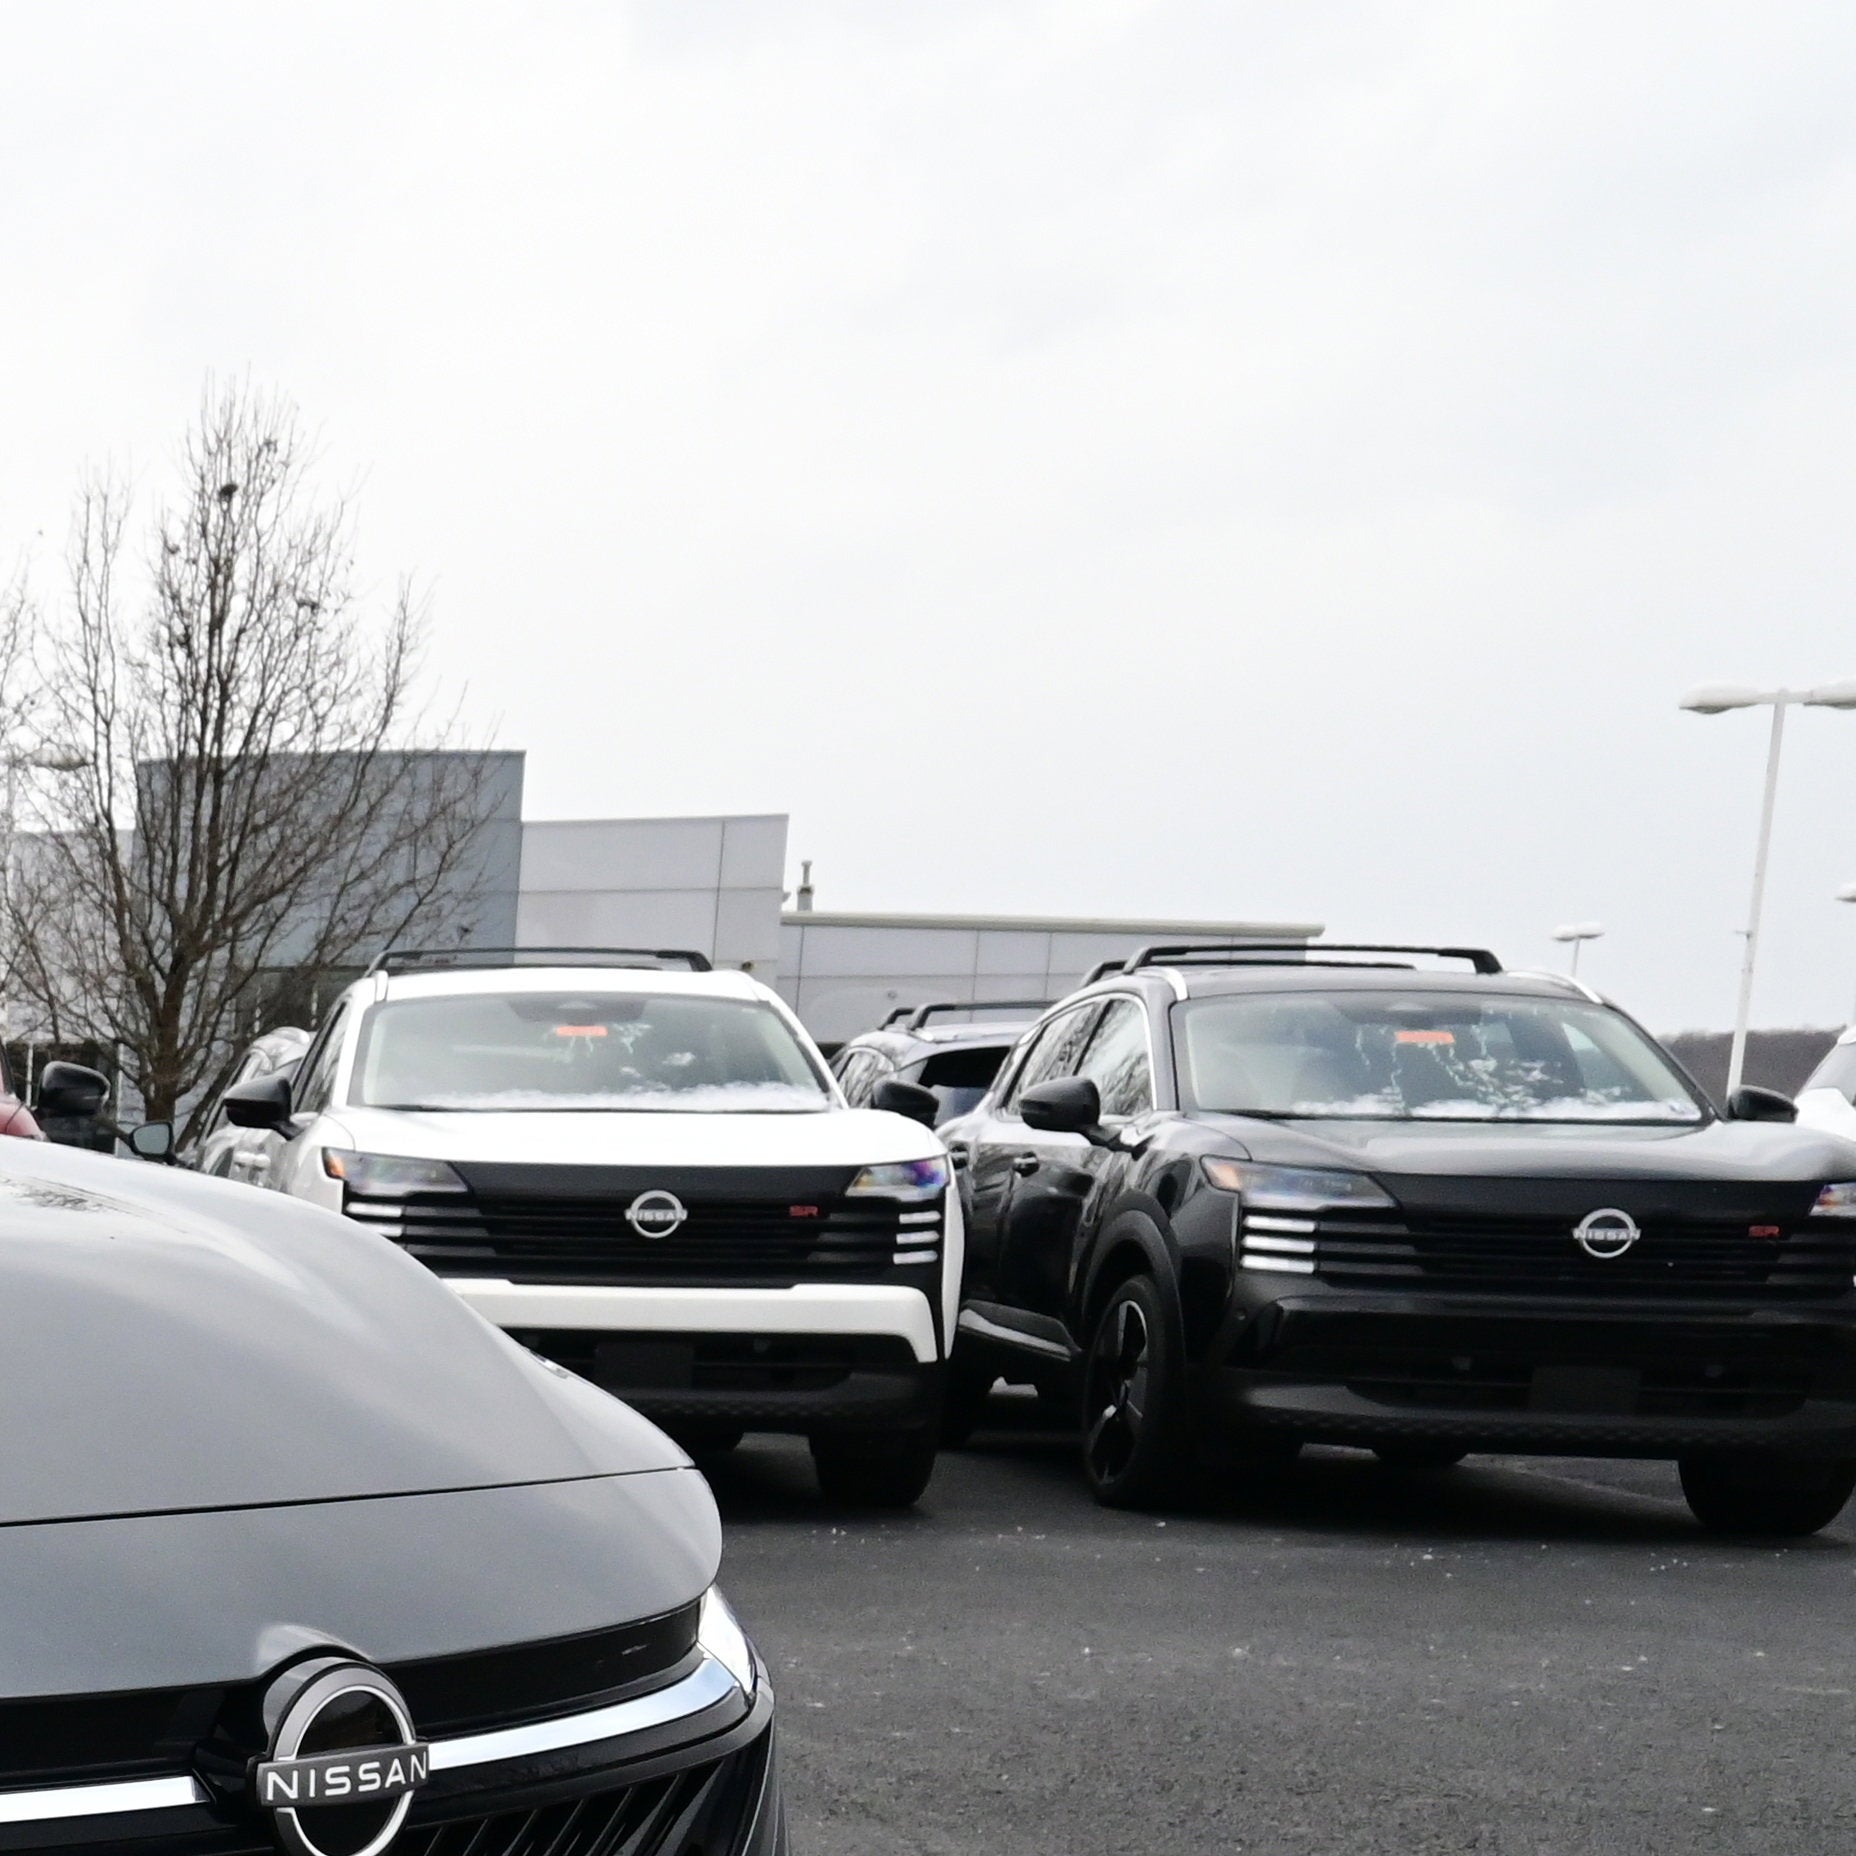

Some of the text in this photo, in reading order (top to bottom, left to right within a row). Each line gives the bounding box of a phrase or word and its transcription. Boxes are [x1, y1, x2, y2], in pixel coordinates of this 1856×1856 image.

[625, 1209, 688, 1221] NISSAN
[789, 1205, 818, 1217] SR
[1573, 1228, 1641, 1241] NISSAN
[1748, 1226, 1780, 1237] SR
[266, 1751, 428, 1801] NISSAN
